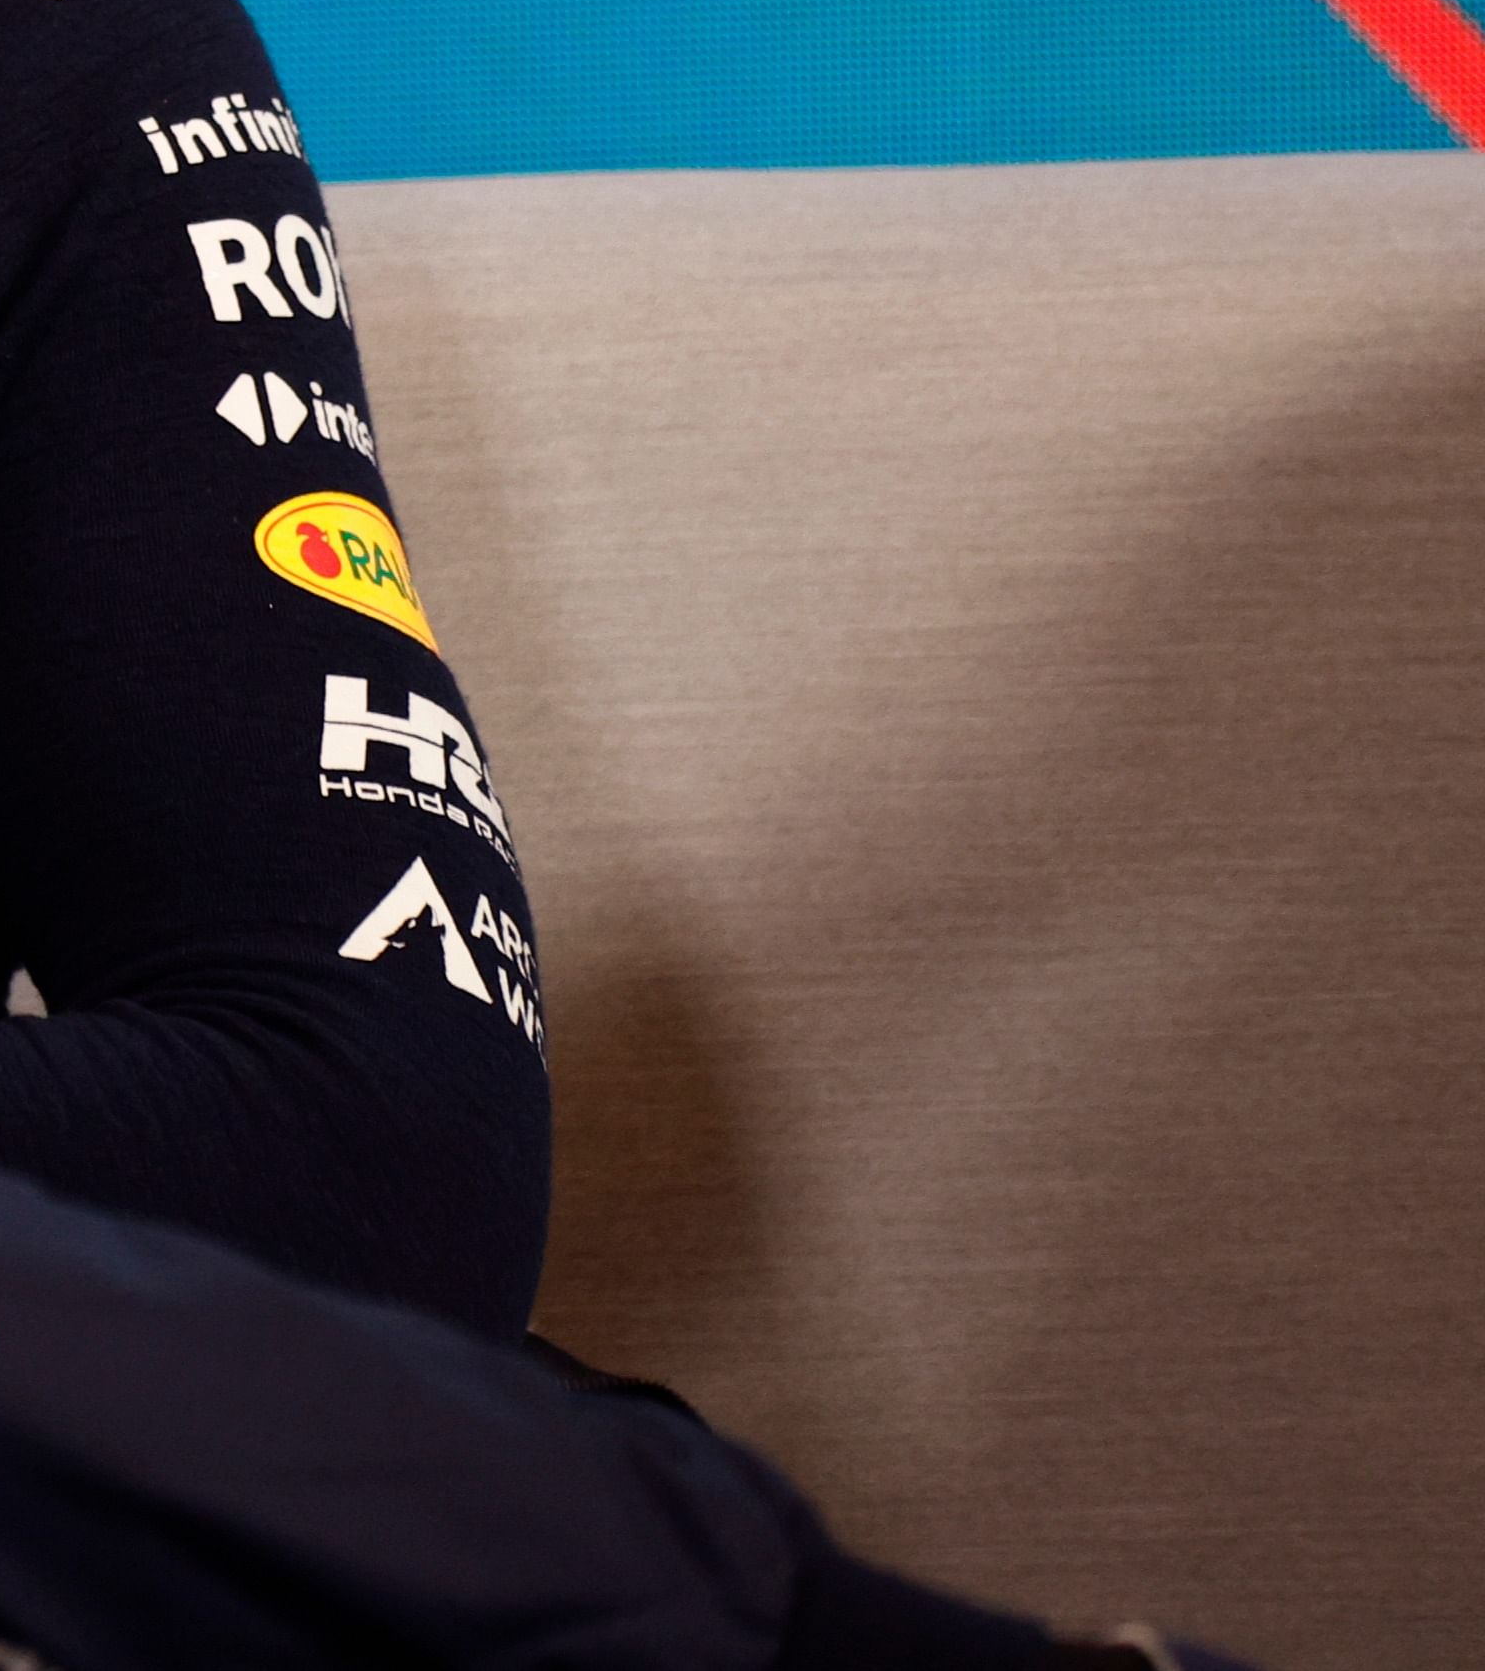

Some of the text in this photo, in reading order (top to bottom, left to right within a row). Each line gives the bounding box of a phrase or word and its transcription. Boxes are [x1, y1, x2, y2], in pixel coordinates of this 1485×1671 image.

[138, 93, 311, 176] infini
[186, 214, 352, 329] RO
[309, 381, 377, 467] inte
[319, 674, 514, 846] HR
[319, 772, 471, 830] Honda
